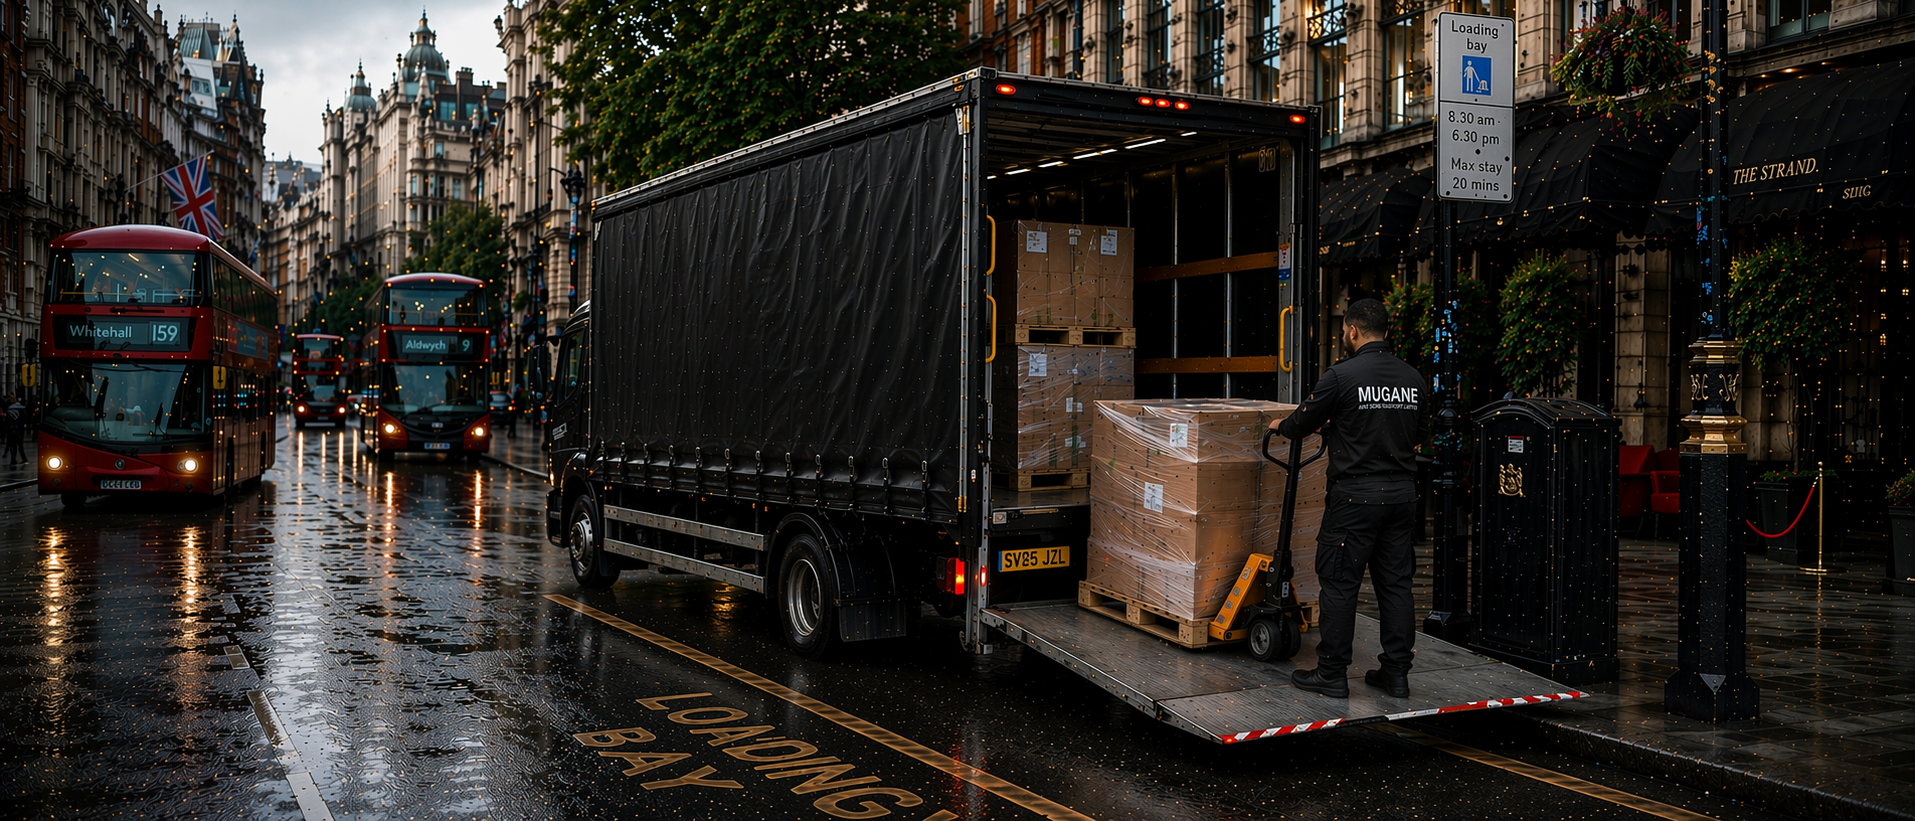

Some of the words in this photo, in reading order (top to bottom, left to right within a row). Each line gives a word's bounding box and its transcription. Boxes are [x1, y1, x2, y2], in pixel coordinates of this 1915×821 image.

[1451, 19, 1499, 39] Loading
[1466, 38, 1488, 54] bay
[1448, 110, 1474, 124] 8.30
[1477, 115, 1495, 126] am
[1452, 129, 1477, 142] 6.30
[1482, 135, 1500, 148] pm
[1451, 157, 1475, 171] Max
[1478, 161, 1503, 176] stay
[1733, 166, 1758, 186] THE
[1452, 177, 1467, 190] 20
[1471, 179, 1500, 191] mins
[69, 323, 132, 339] Whitehall
[152, 324, 179, 342] 159
[405, 339, 446, 353] Aldwych
[462, 339, 470, 353] 9
[1357, 386, 1419, 404] MUGANE
[1042, 549, 1066, 565] JZL
[573, 726, 744, 790] BAY
[635, 691, 924, 820] LOADING
